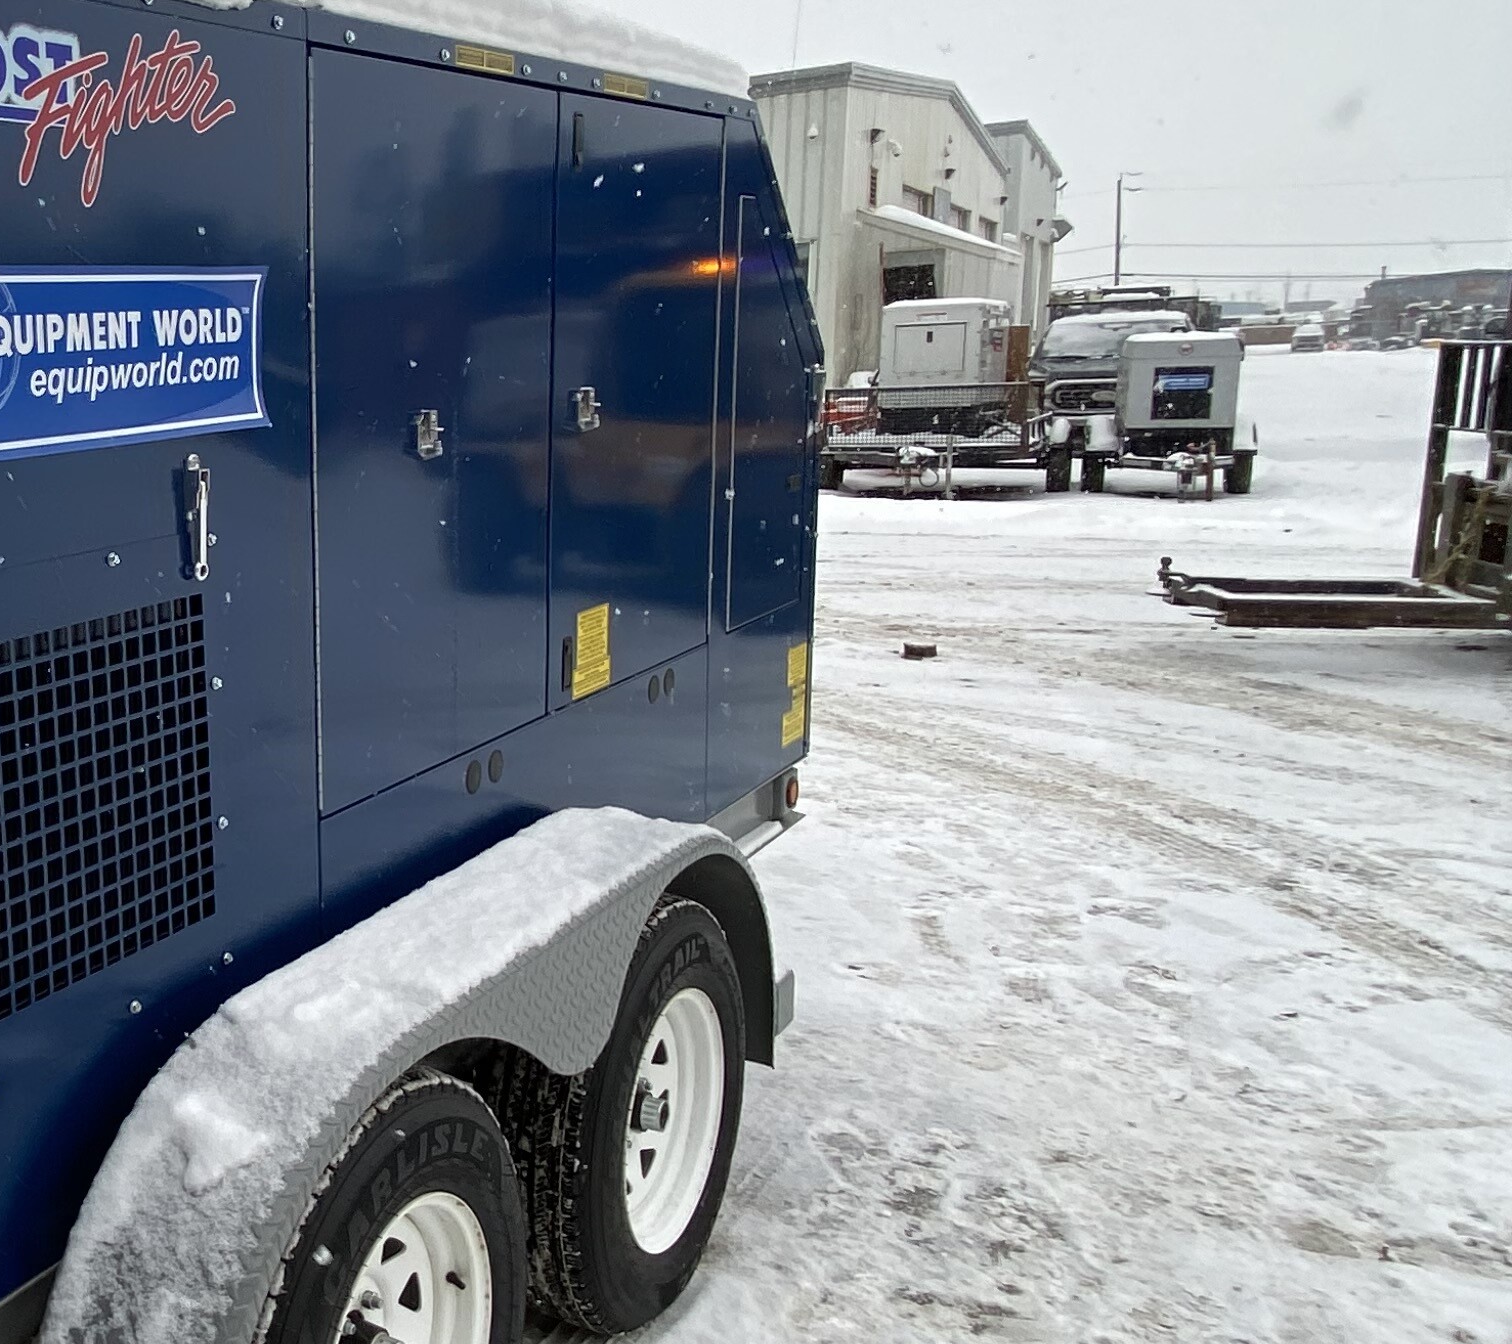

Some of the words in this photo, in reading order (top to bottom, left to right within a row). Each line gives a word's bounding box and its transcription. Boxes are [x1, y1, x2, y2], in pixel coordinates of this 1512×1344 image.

[18, 29, 236, 208] Fighter
[153, 306, 243, 348] WORLD
[29, 350, 240, 405] equipworld.com
